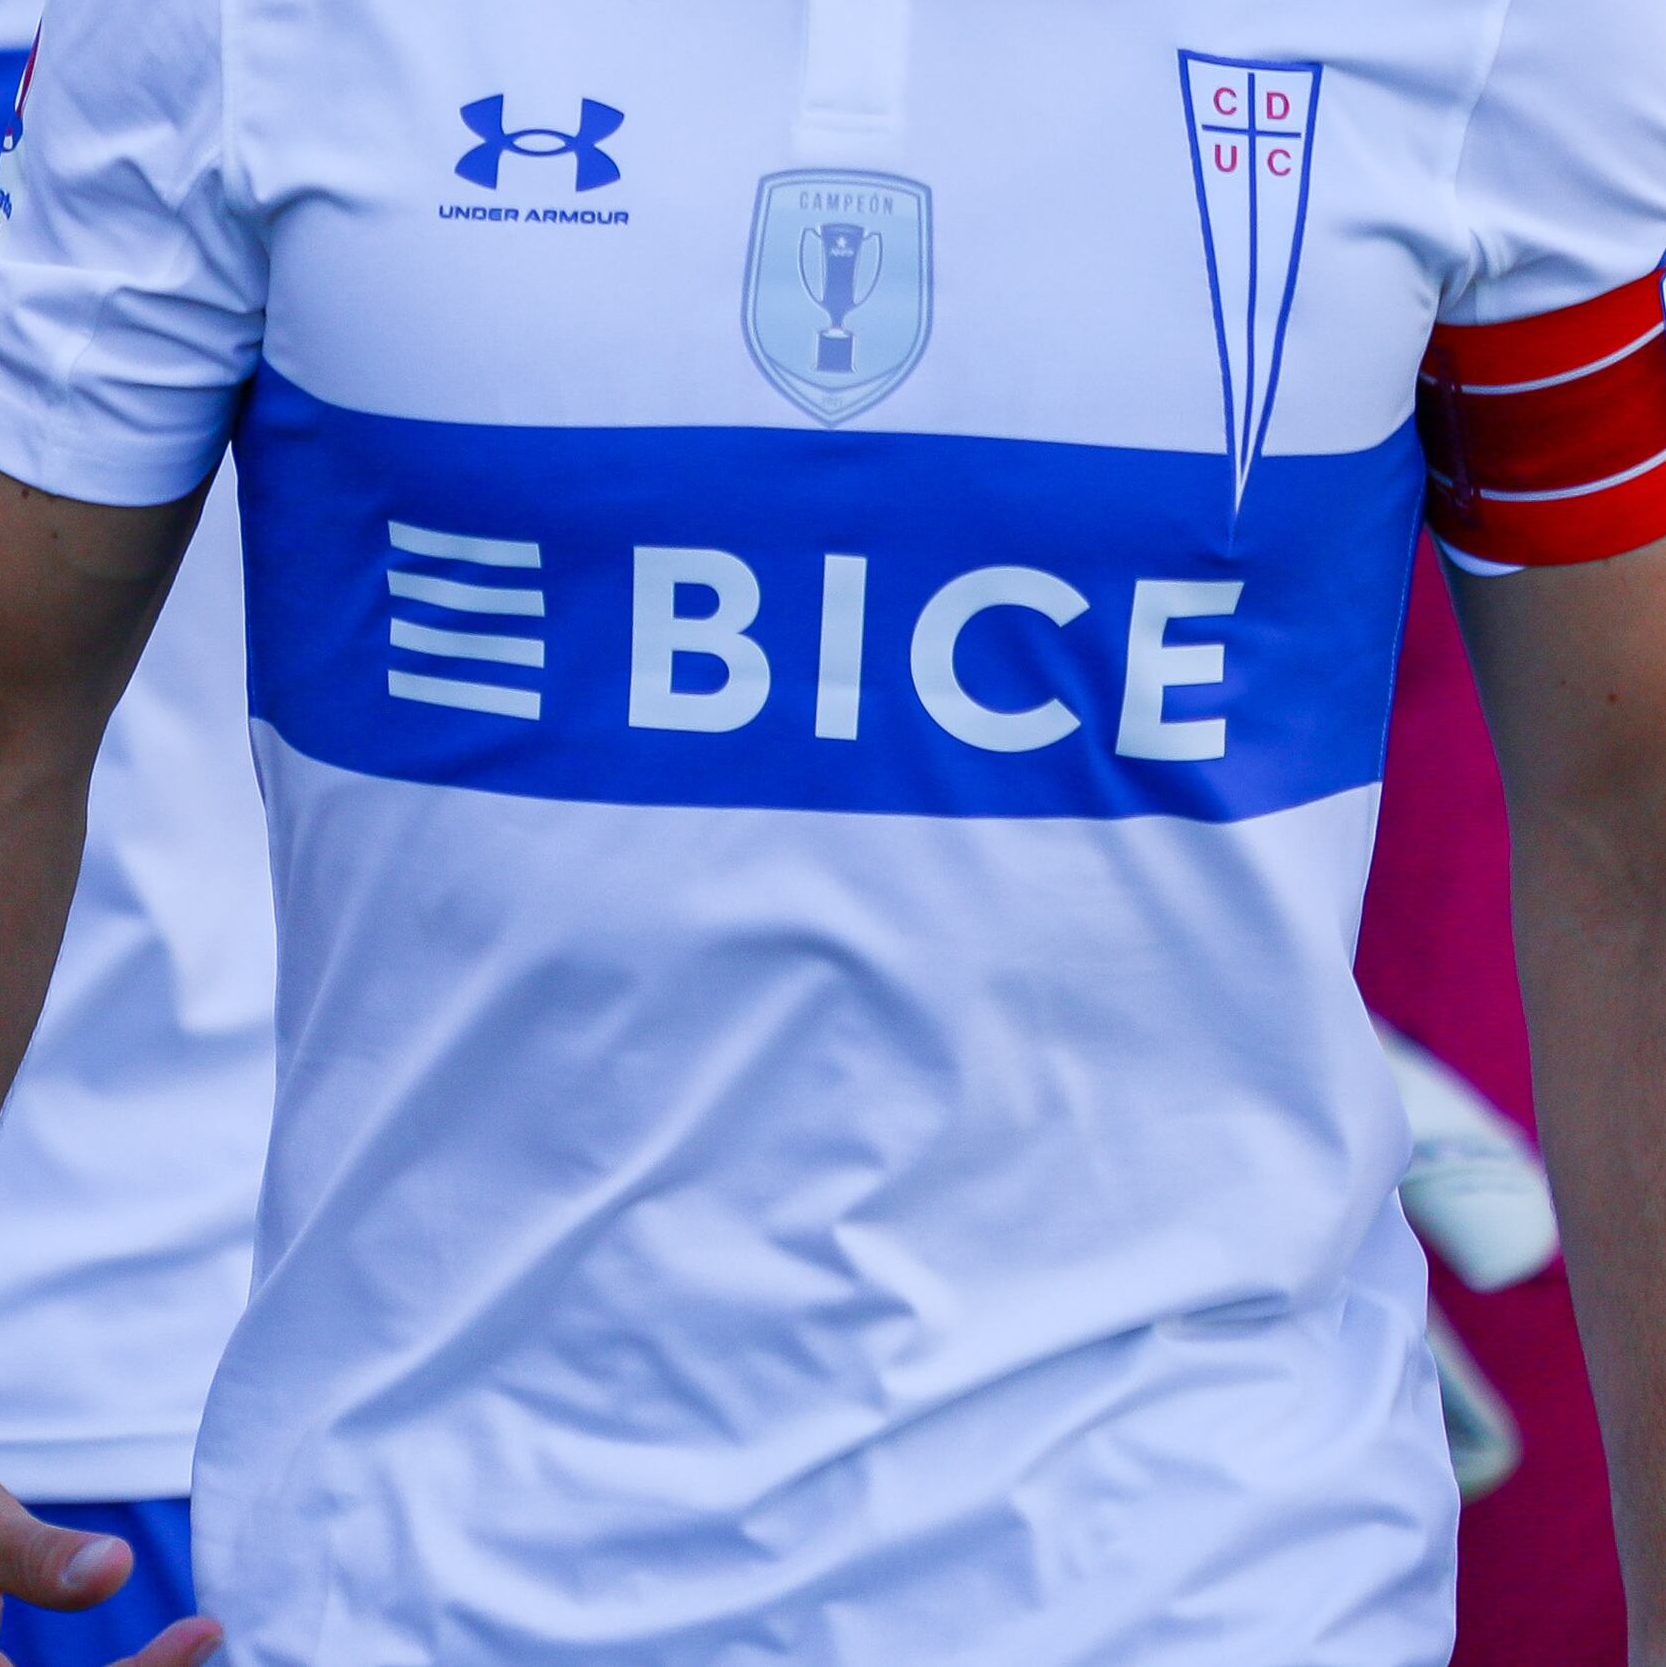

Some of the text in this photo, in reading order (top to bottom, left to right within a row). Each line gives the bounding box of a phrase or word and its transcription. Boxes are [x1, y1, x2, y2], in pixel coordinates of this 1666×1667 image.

[439, 205, 629, 225] UNDER ARMOUR
[628, 545, 1245, 762] BICE
